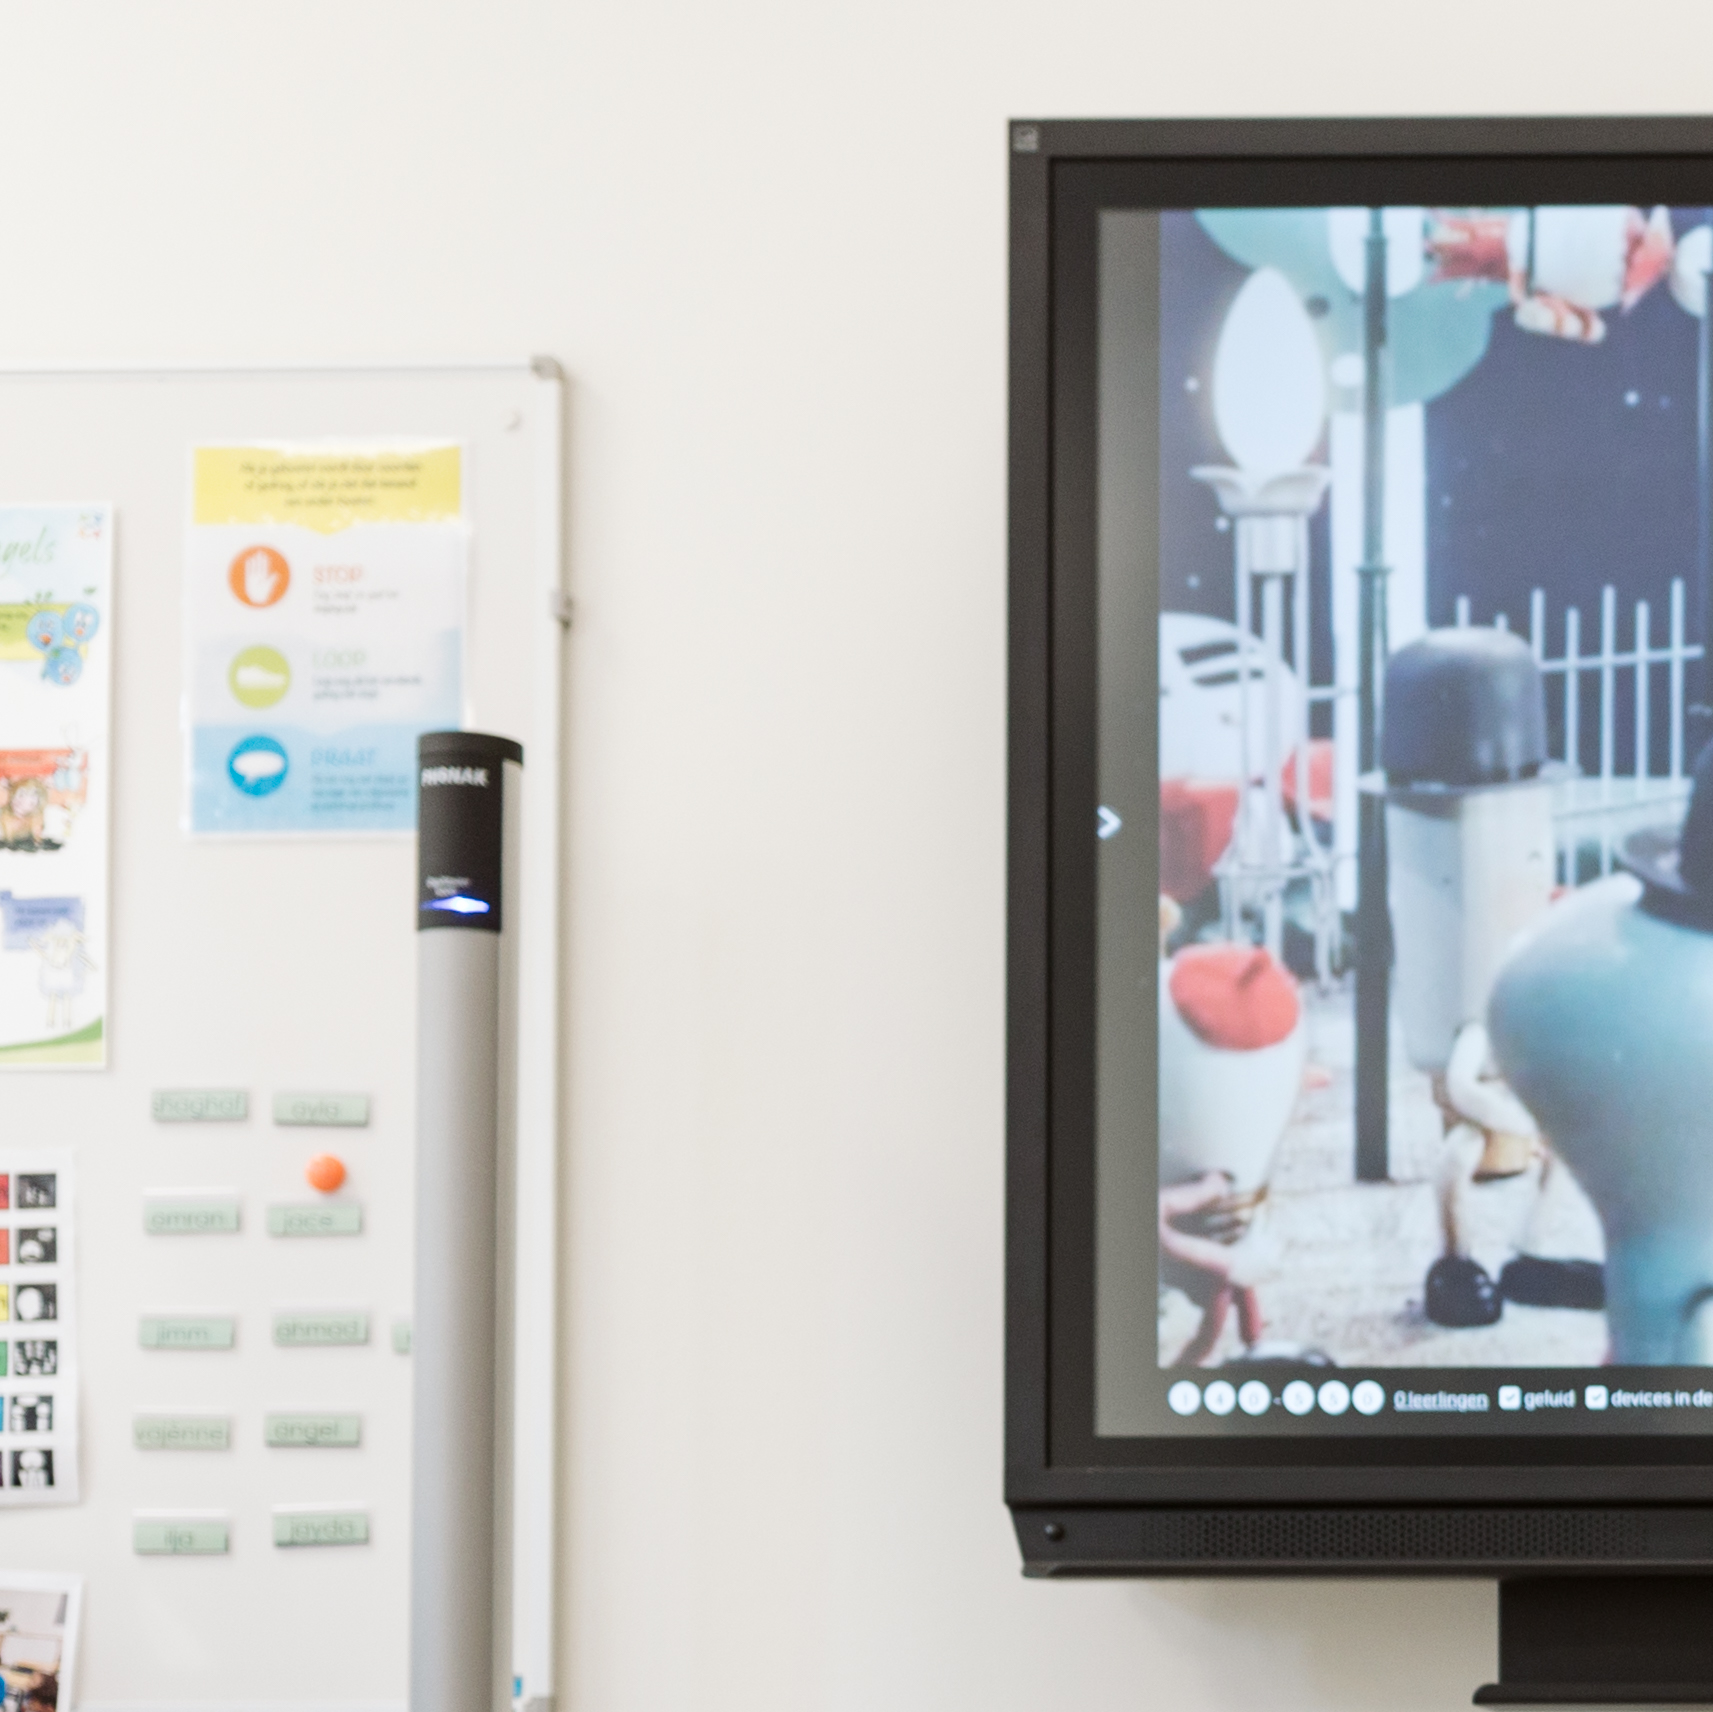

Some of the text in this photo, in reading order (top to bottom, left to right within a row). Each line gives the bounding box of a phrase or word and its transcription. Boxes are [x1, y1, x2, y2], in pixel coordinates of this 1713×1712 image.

[0, 526, 57, 577] gels
[312, 564, 363, 584] STOP
[1407, 1390, 1490, 1412] leerlingen
[1523, 1389, 1576, 1411] geluid
[1610, 1388, 1672, 1408] devices
[1674, 1389, 1690, 1407] in
[1692, 1389, 1713, 1408] de
[273, 1421, 340, 1446] angel
